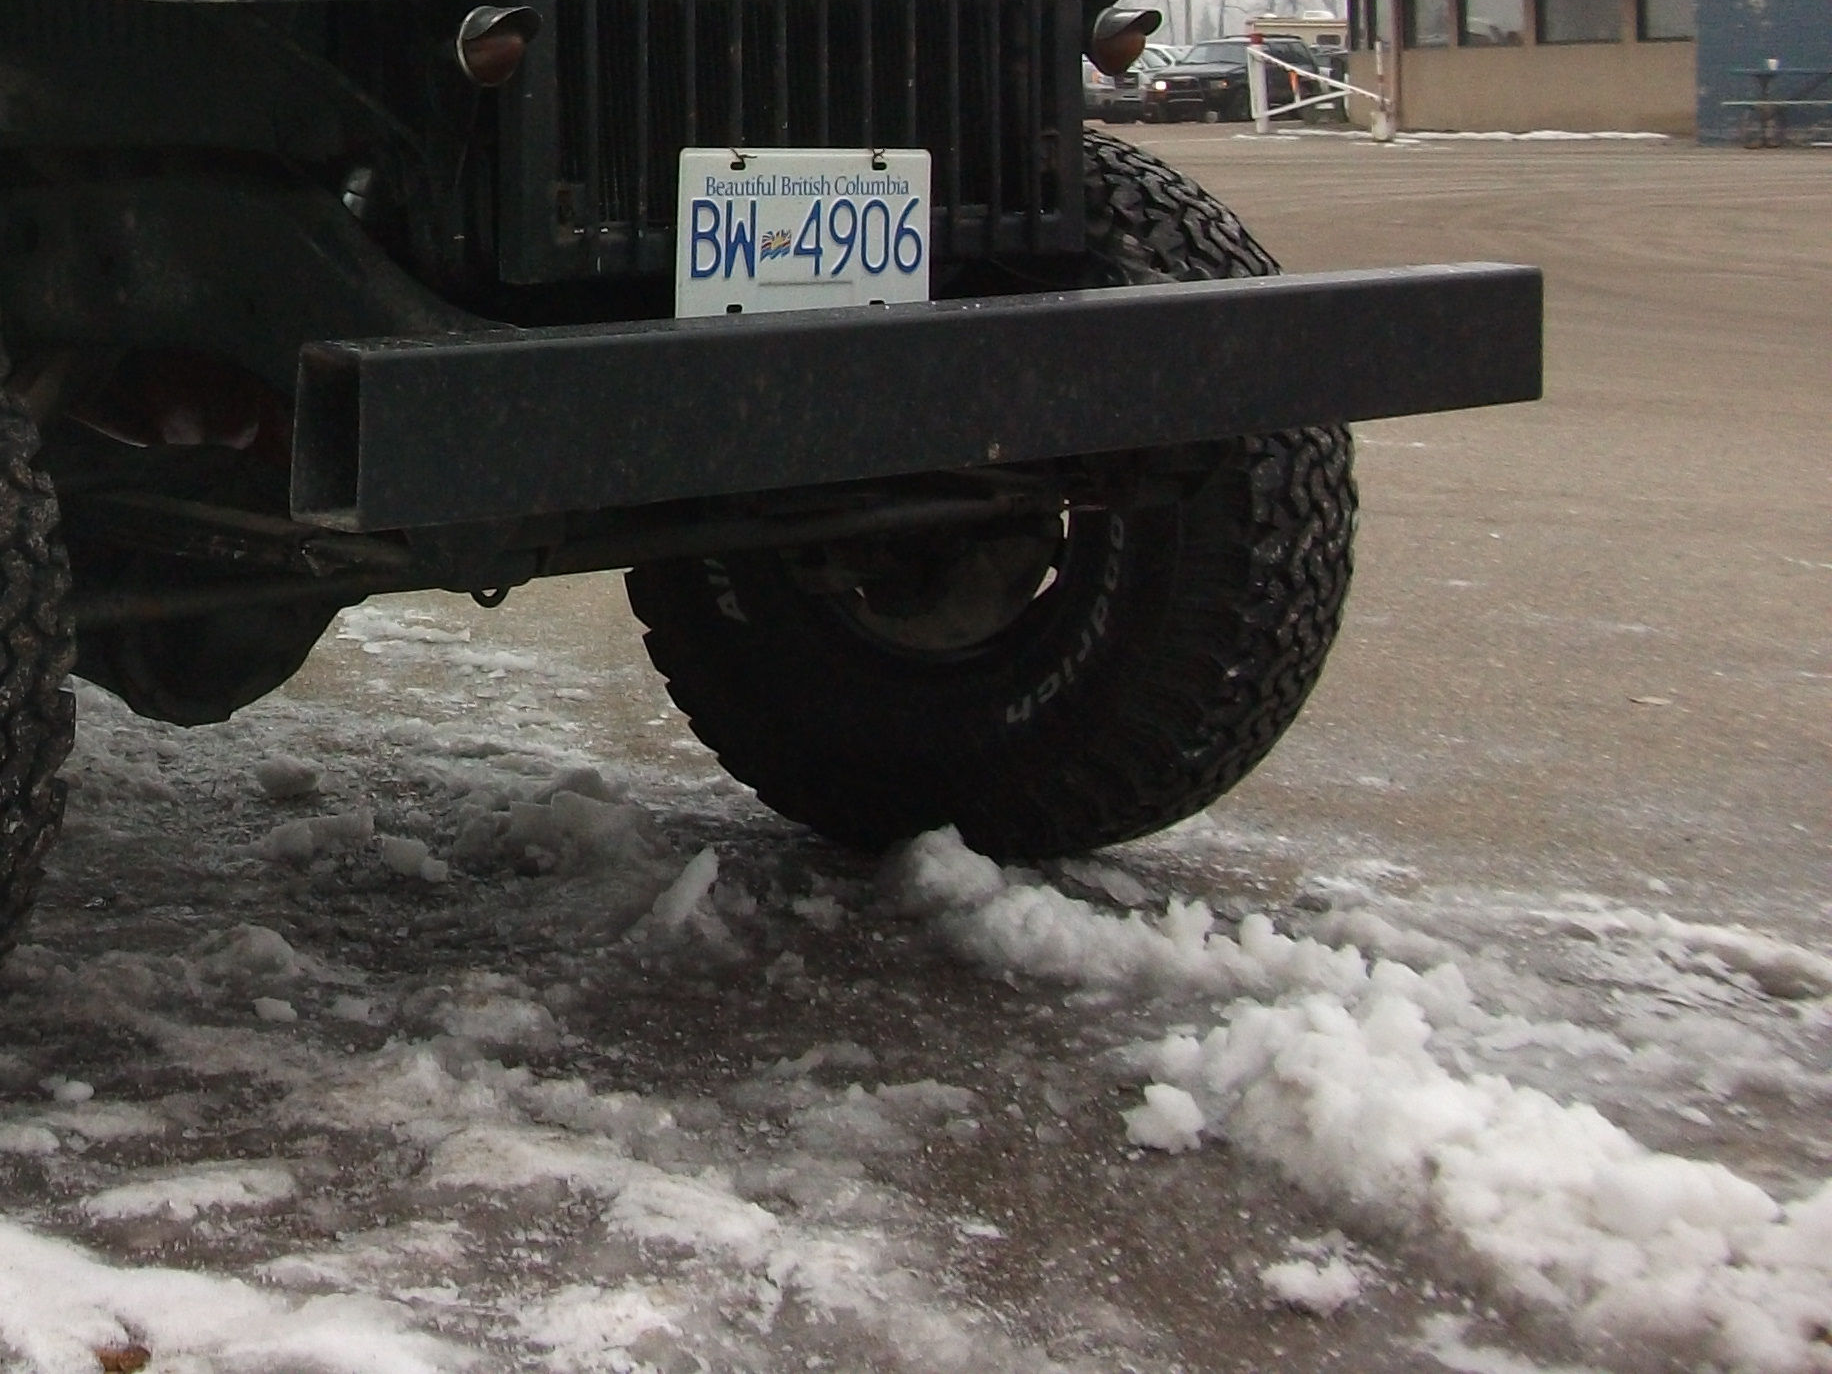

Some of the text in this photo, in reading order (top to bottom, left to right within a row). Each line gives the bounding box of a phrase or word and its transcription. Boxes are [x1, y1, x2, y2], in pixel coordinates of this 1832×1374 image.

[705, 175, 910, 197] Beautiful British Columbia
[690, 197, 923, 279] BW 4906
[1005, 512, 1125, 725] oodrich
